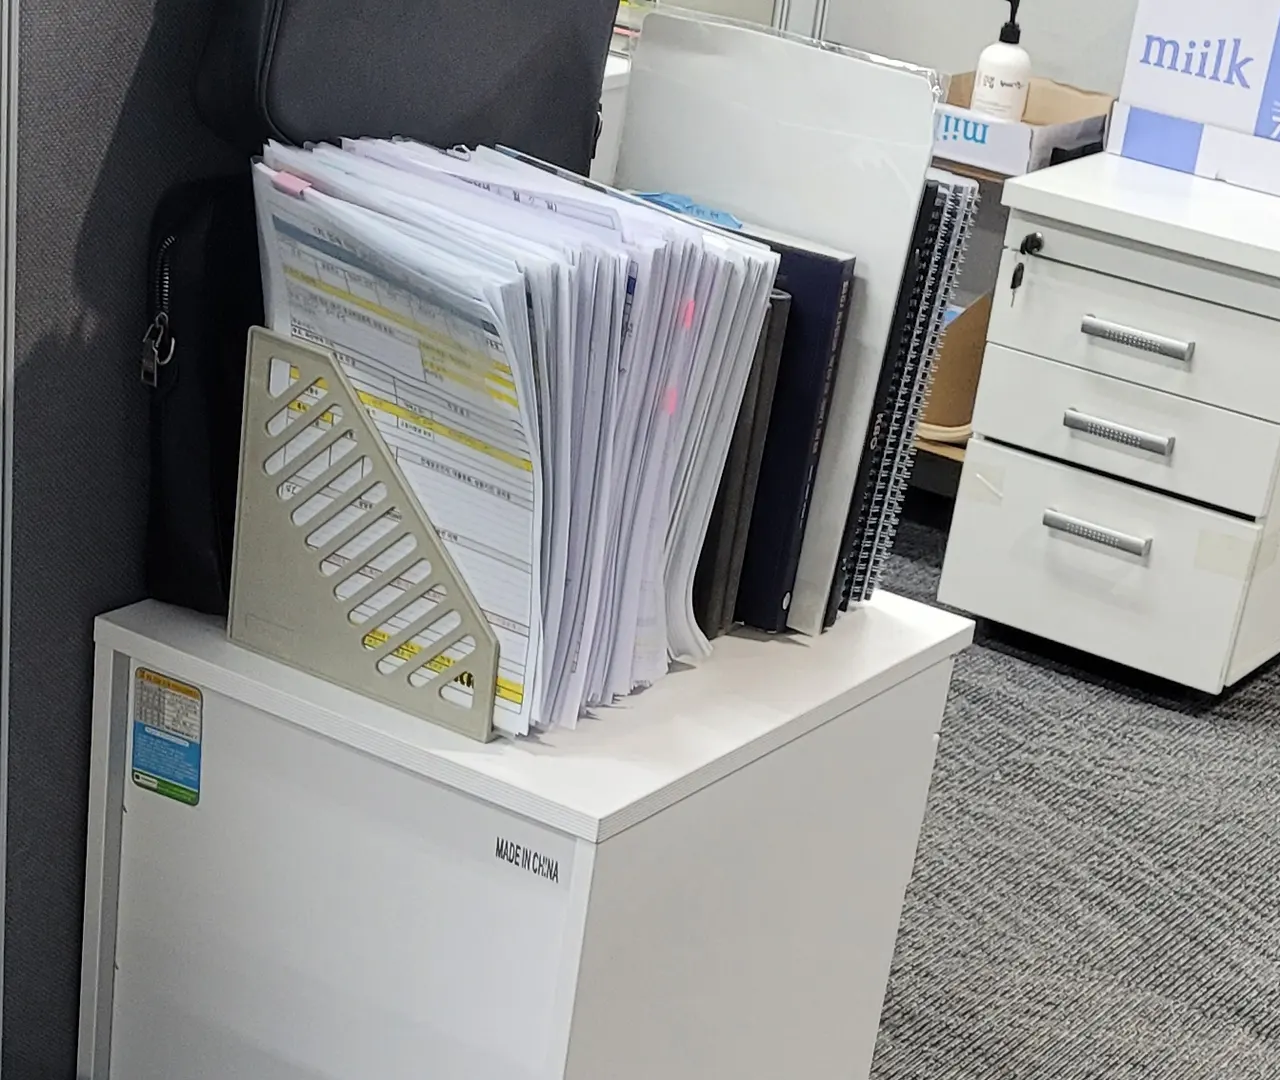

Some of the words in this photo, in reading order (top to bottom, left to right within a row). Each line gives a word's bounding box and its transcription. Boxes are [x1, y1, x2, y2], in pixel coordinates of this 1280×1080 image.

[1140, 34, 1254, 89] miilk
[943, 114, 990, 145] mii
[496, 836, 521, 867] MADE
[521, 847, 532, 871] IN
[532, 851, 559, 884] CHINA
